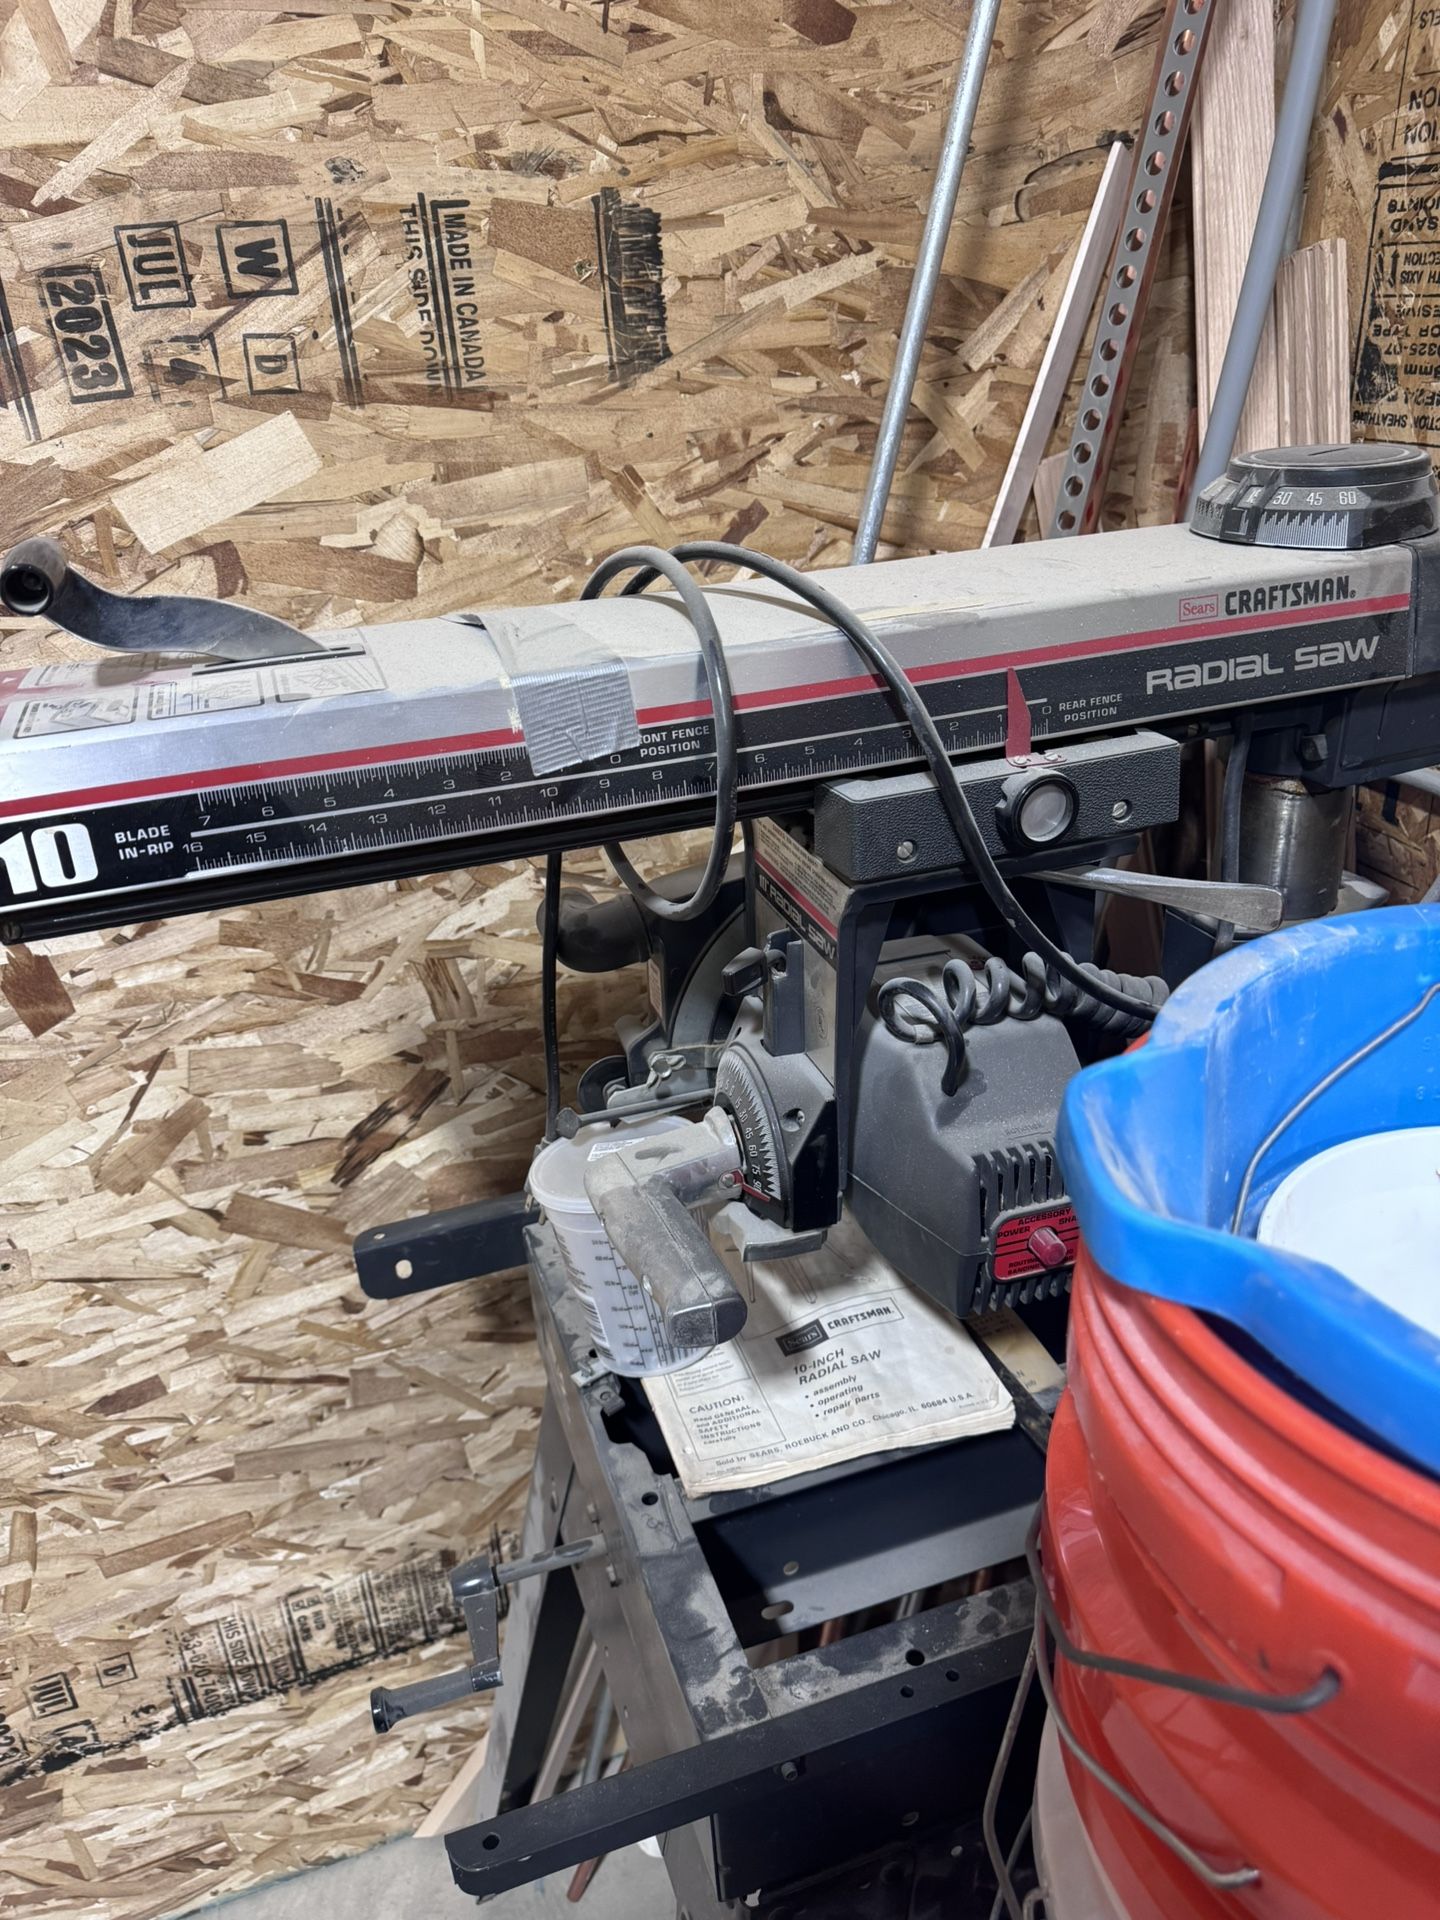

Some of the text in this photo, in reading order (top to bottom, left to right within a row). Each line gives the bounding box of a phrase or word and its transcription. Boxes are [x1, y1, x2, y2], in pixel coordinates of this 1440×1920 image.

[233, 237, 282, 278] W
[126, 233, 181, 301] JUL
[443, 212, 487, 382] MADE IN CANADA
[45, 278, 120, 390] 2023
[253, 353, 288, 375] D
[1272, 490, 1293, 506] 30
[1305, 490, 1324, 506] 45
[1339, 490, 1357, 505] 60
[1182, 600, 1216, 617] Sears
[1058, 693, 1123, 712] REAR FENCE
[1063, 706, 1118, 723] POSITION
[671, 724, 711, 742] FENCE
[949, 721, 960, 731] 2
[639, 739, 701, 758] POSITION
[853, 737, 864, 746] 4
[803, 744, 815, 756] 5
[754, 752, 766, 763] 6
[500, 770, 512, 781] 2
[651, 769, 664, 781] 8
[442, 779, 456, 790] 3
[599, 777, 611, 789] 9
[383, 788, 396, 799] 4
[539, 786, 559, 799] 10
[322, 796, 337, 808] 5
[487, 795, 502, 807] 11
[261, 805, 275, 817] 6
[427, 803, 447, 816] 12
[197, 814, 212, 826] 7
[367, 813, 388, 825] 13
[113, 824, 171, 844] BLADE
[307, 822, 328, 834] 14
[245, 831, 267, 844] 15
[118, 840, 174, 861] IN-RIP
[182, 841, 204, 854] 16
[0, 822, 99, 895] 10
[738, 1110, 749, 1123] 30
[745, 1127, 754, 1140] 45
[748, 1144, 758, 1158] 60
[751, 1164, 761, 1176] 75
[1017, 1208, 1072, 1227] ACCESSORY
[996, 1225, 1031, 1239] POWER
[793, 1348, 845, 1375] 10-INCH
[798, 1349, 881, 1386] RADIAL SAW
[813, 1375, 857, 1396] assembly
[817, 1384, 863, 1406] operating
[823, 1391, 880, 1416] repair parts
[698, 1424, 729, 1434] SAFETY
[700, 1421, 762, 1440] INSTRUCTIONS
[784, 1433, 829, 1450] ROEBUCK
[831, 1423, 850, 1436] AND
[229, 1640, 250, 1666] SIDE
[29, 1680, 70, 1714] JUL
